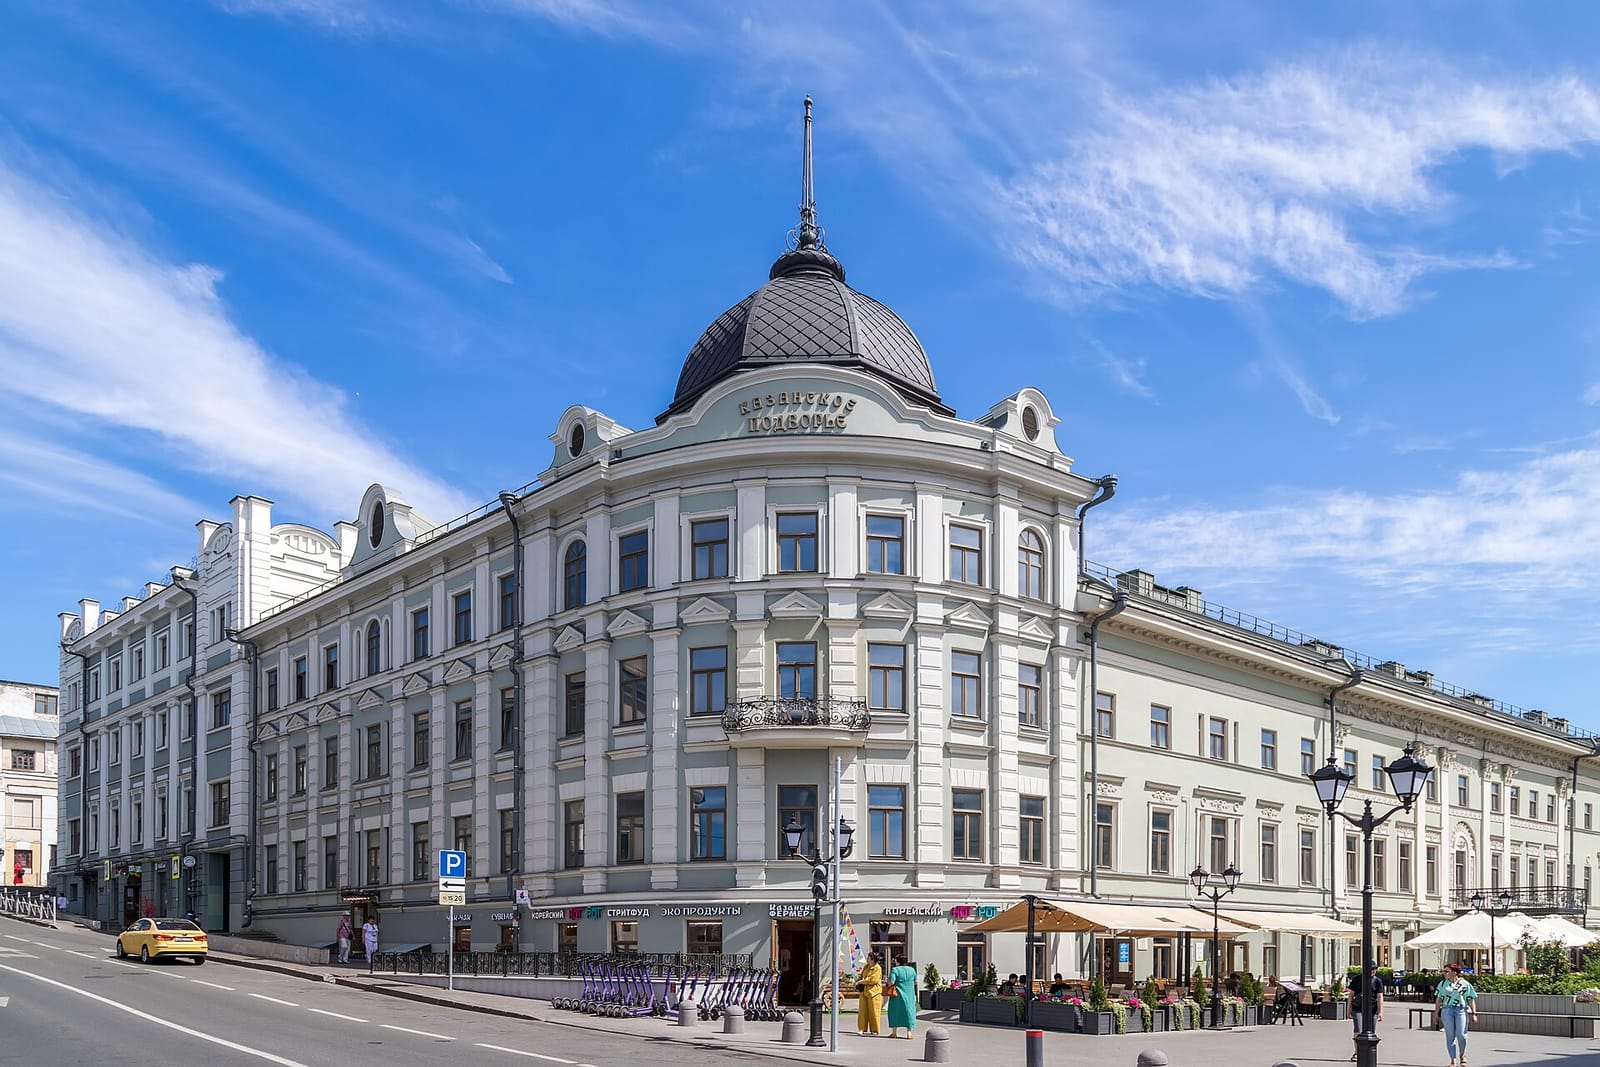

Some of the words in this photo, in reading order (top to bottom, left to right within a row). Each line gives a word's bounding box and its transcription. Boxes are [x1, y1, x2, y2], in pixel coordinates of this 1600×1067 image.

[739, 391, 858, 415] КАЗАНСКОЕ
[748, 414, 847, 432] ПОДВОРЬЕ
[446, 853, 461, 875] P
[607, 908, 650, 917] СТРИТФУД
[660, 908, 681, 916] ЭКО
[683, 906, 741, 916] ПРОДУКТЫ
[769, 903, 818, 911] Казански
[884, 905, 944, 917] КОРЕЙСКИЙ
[531, 910, 564, 919] КОРЕЙСКИЙ
